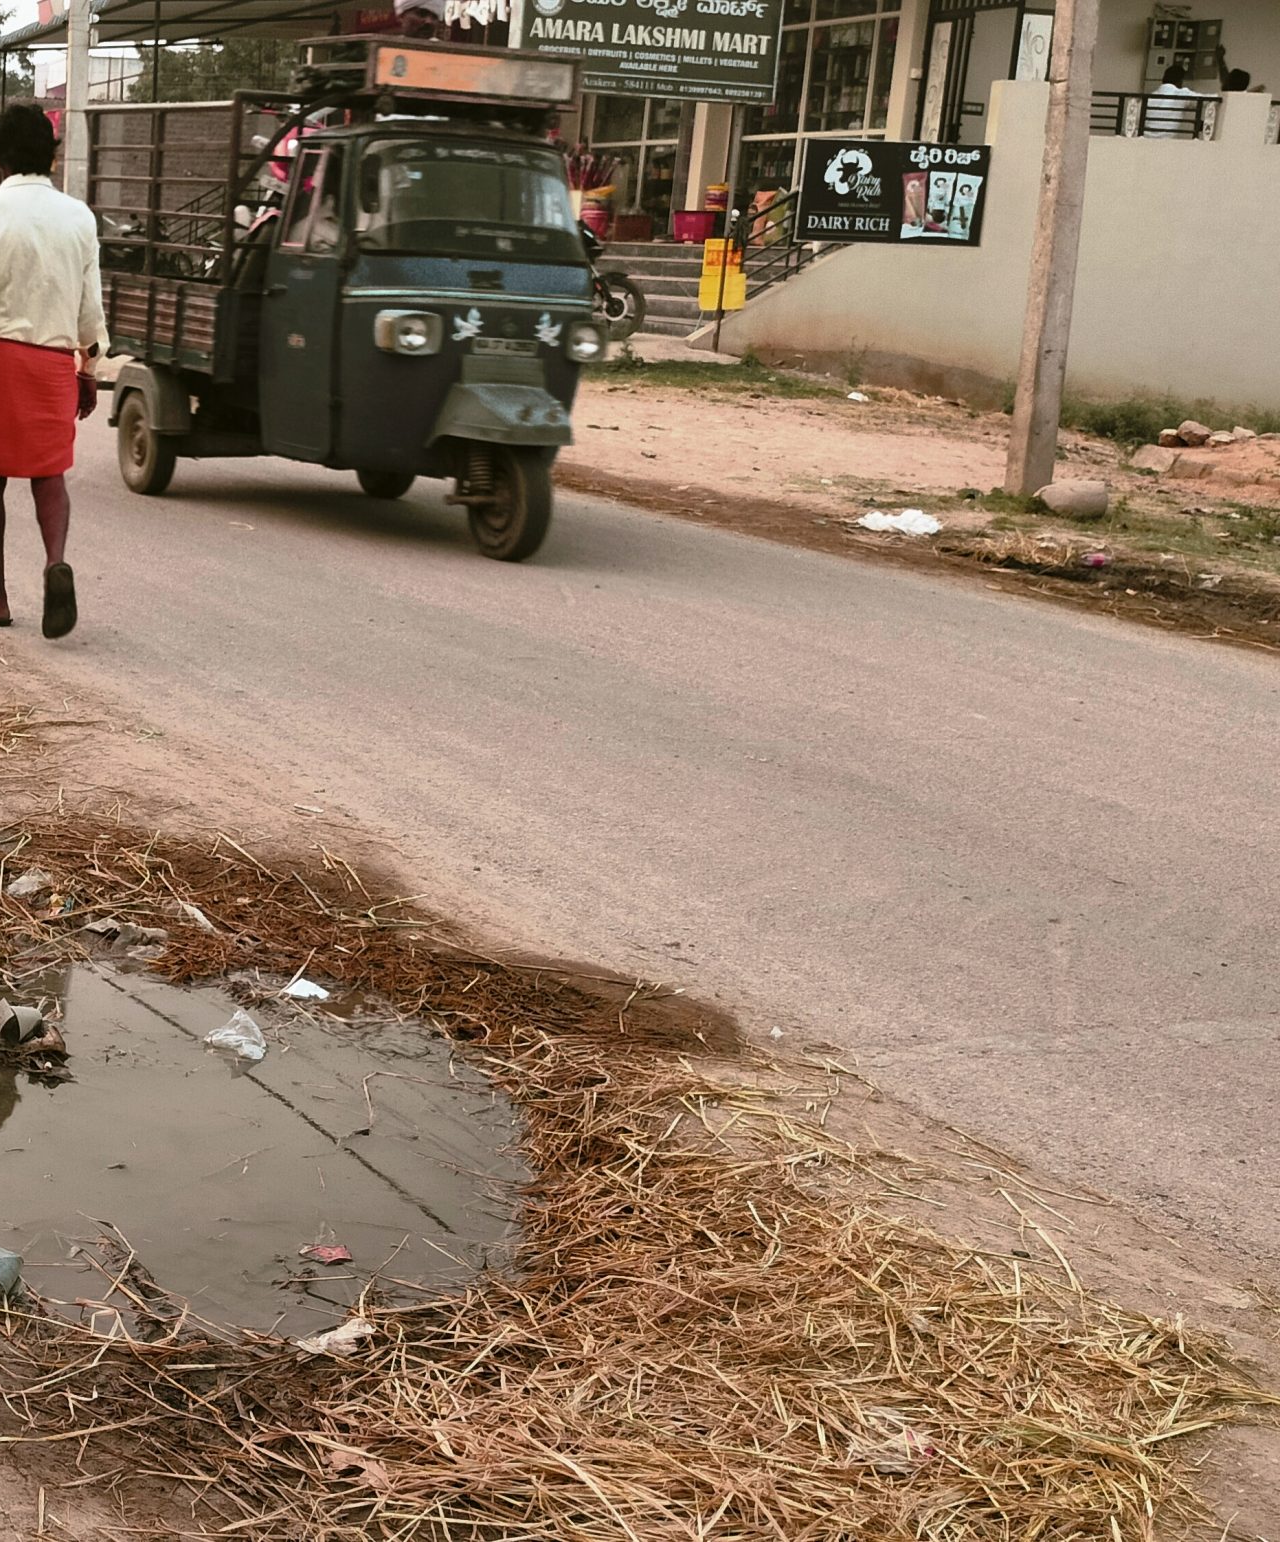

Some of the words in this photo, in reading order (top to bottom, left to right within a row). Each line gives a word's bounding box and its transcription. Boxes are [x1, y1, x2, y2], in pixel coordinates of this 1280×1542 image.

[529, 17, 604, 43] AMARA
[611, 23, 706, 50] LAKSHMI
[713, 31, 771, 55] MART
[619, 61, 657, 71] AVAILABLE
[658, 64, 678, 73] HERE
[634, 51, 676, 62] COSMETICS
[683, 55, 712, 65] MILLETS
[719, 58, 759, 69] VEGETABLE
[910, 145, 942, 169] ಡೈರಿ
[856, 185, 882, 202] Rich
[807, 214, 851, 231] DAIRY
[855, 216, 890, 232] RICH
